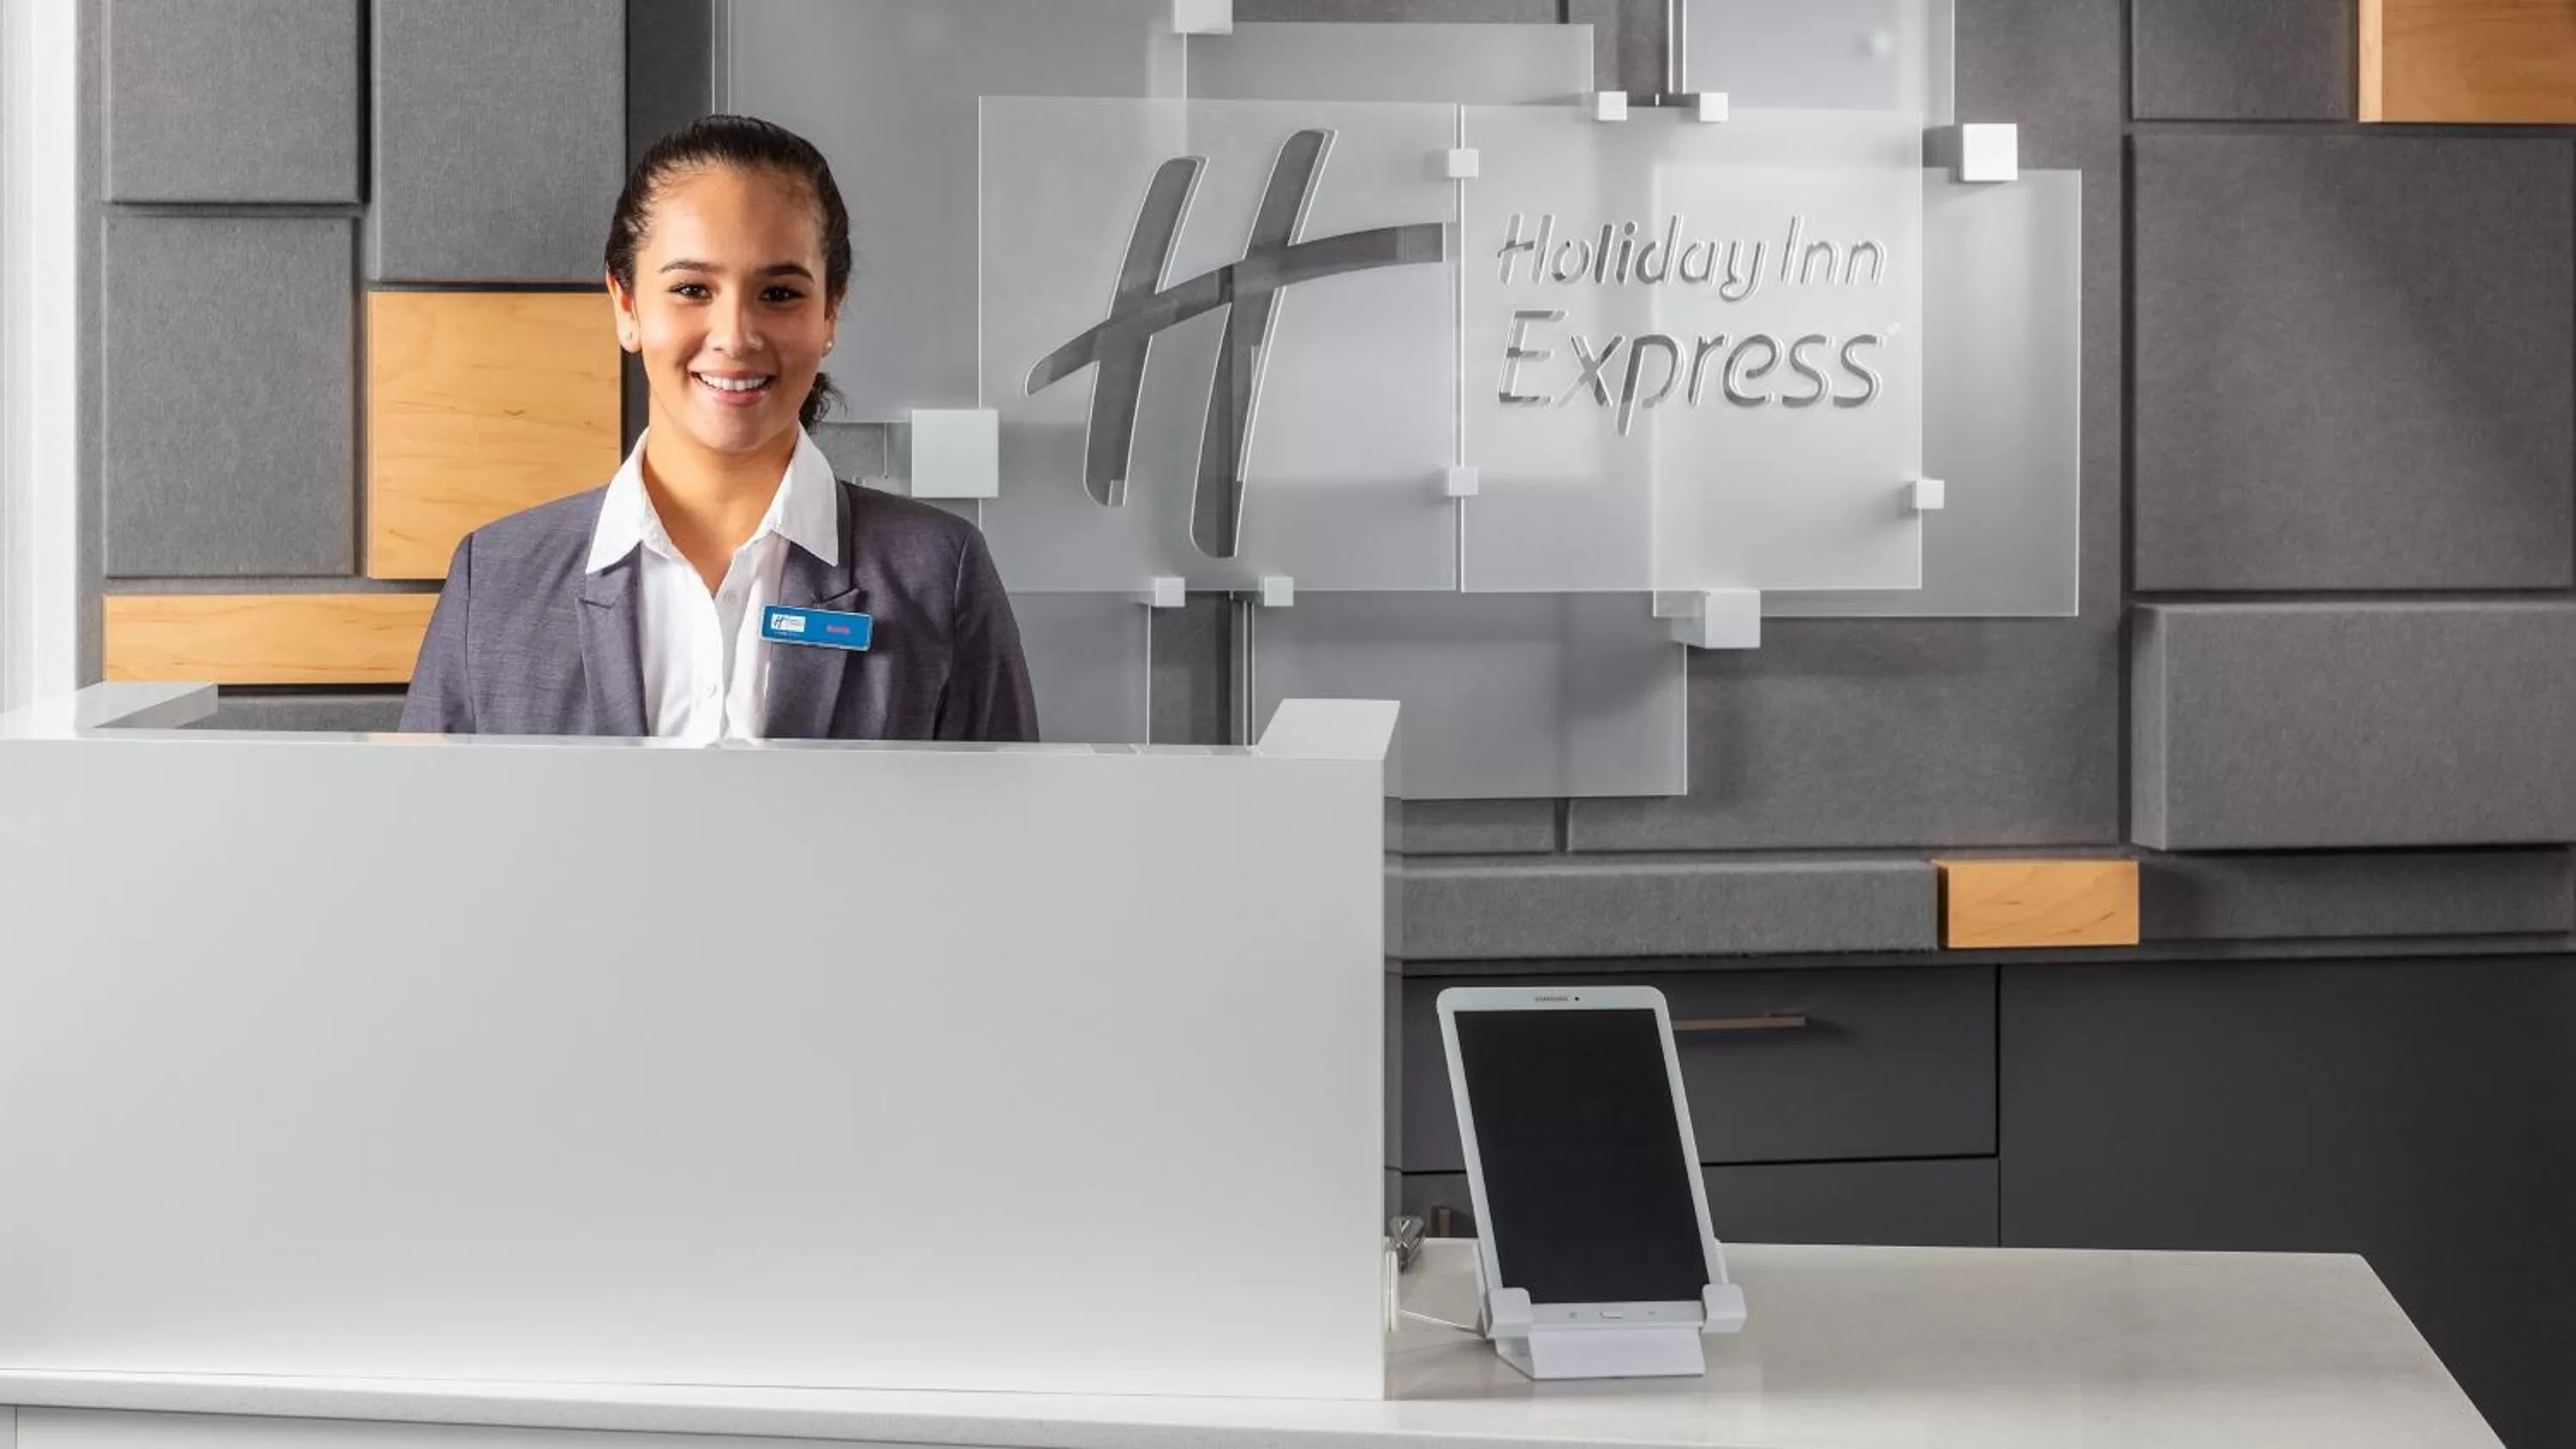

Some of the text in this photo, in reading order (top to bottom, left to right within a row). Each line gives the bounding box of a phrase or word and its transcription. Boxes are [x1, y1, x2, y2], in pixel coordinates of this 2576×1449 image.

[1497, 213, 1887, 302] Holiday Inn
[1498, 309, 1886, 436] Express
